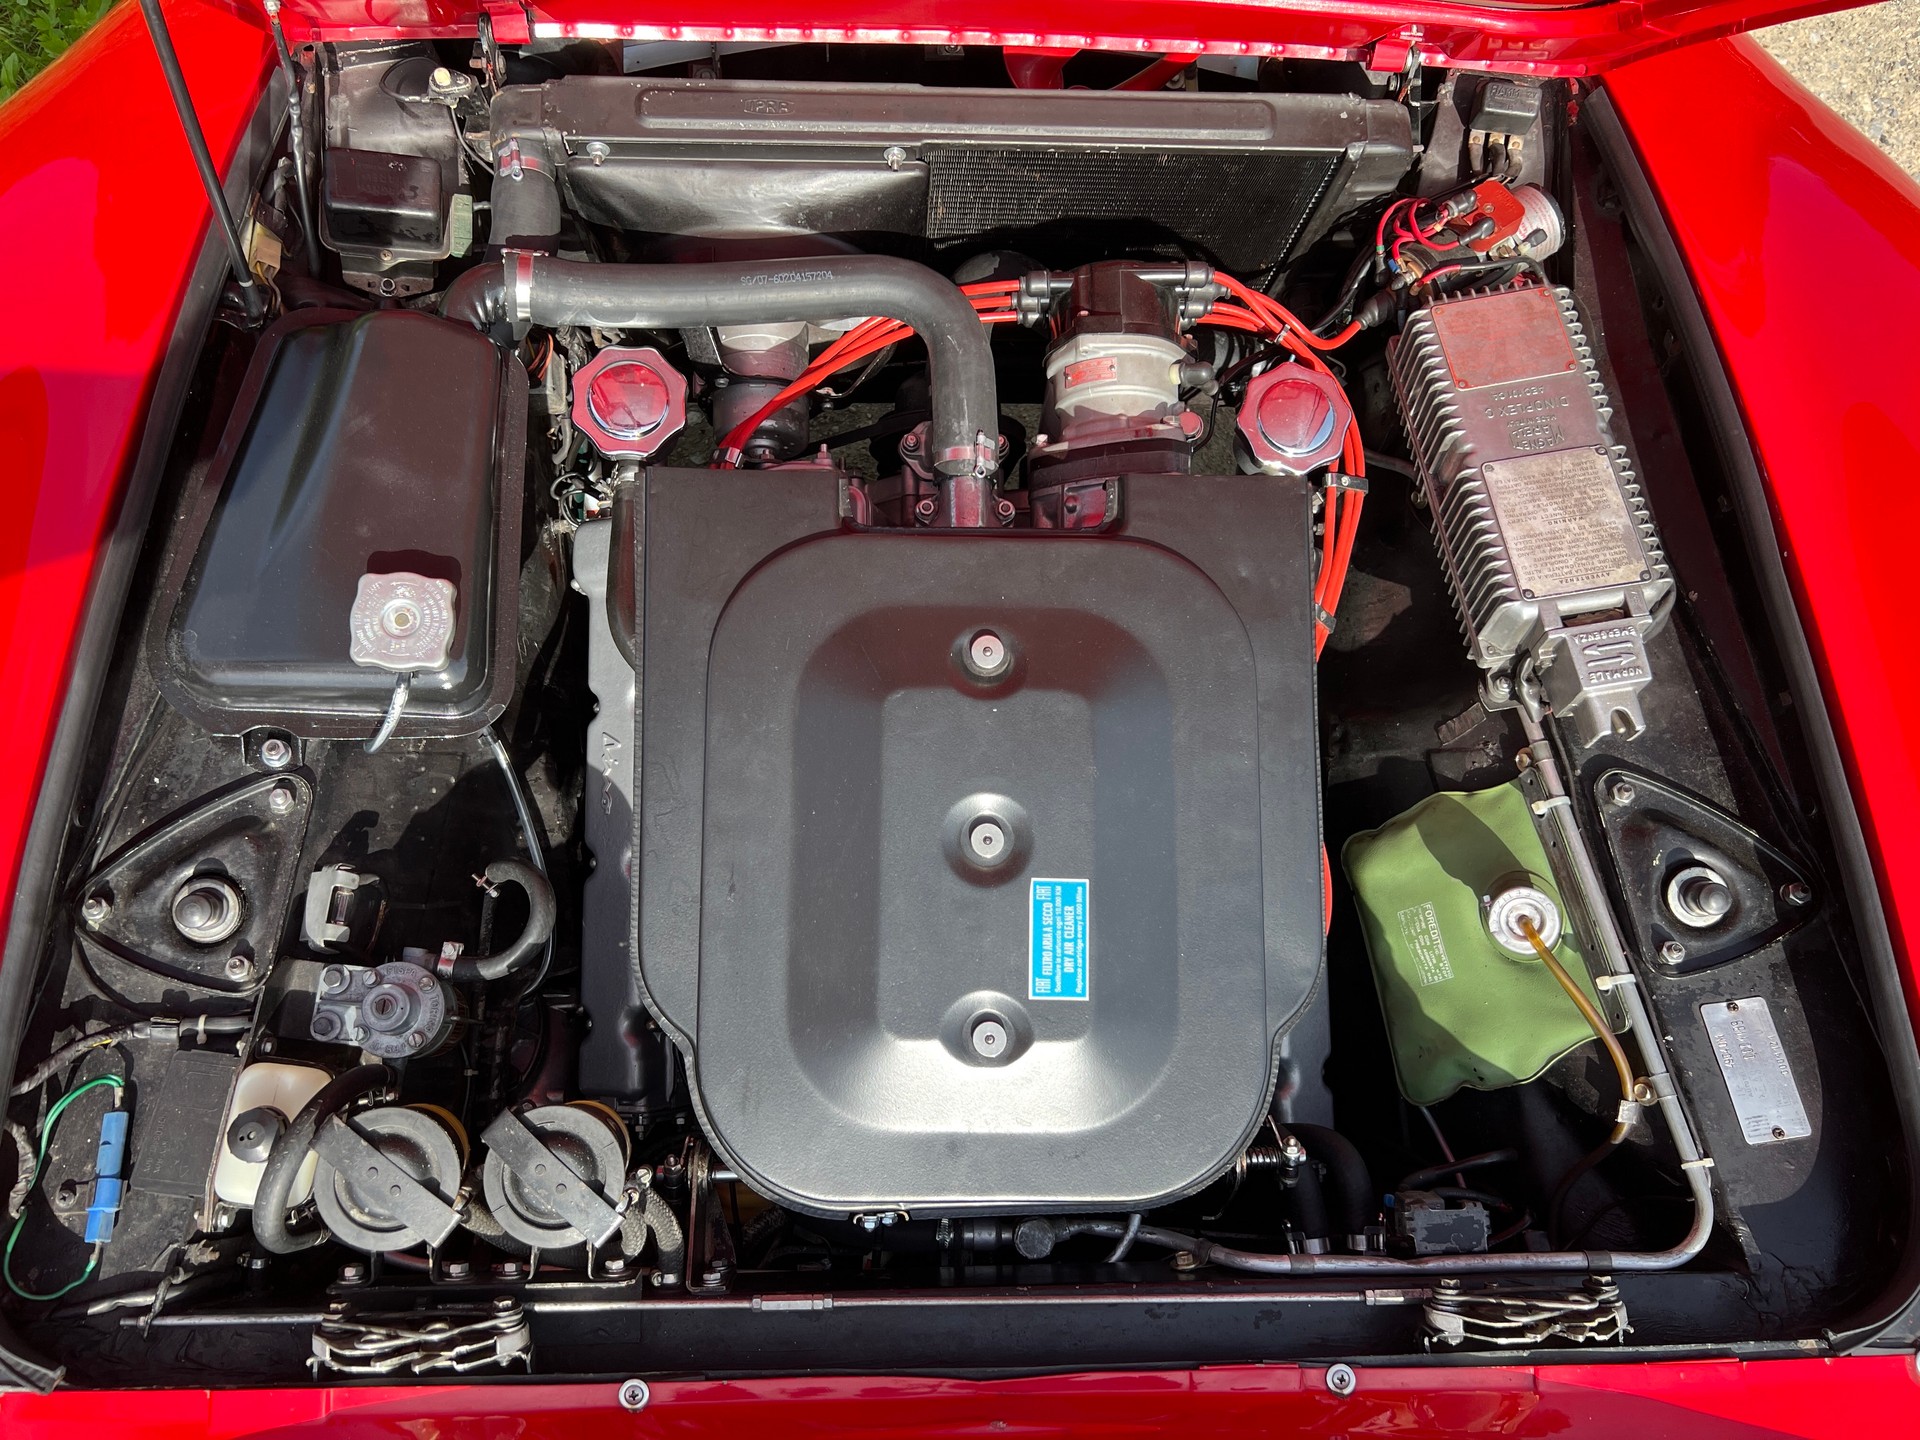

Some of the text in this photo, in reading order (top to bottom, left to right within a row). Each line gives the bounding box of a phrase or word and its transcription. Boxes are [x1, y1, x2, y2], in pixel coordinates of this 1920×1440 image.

[1484, 394, 1568, 419] DINOPLEX C
[1534, 413, 1556, 423] MADE
[1539, 508, 1583, 519] DISCONNECT
[1546, 515, 1584, 525] WARNING
[1546, 560, 1594, 572] FUNZIONANTE
[1558, 571, 1610, 584] AVVERTENZA
[1572, 625, 1637, 644] EMERGENZA
[1588, 665, 1643, 684] NORMALE
[1036, 884, 1051, 900] FIAT
[1055, 885, 1061, 895] KM
[1041, 902, 1053, 925] SECCO
[1055, 915, 1063, 929] ogni
[1421, 903, 1441, 945] FOREDIT
[1041, 933, 1053, 950] ARIA
[1063, 905, 1074, 972] DRY AIR CLEANER
[1075, 939, 1083, 966] cartridge
[1041, 950, 1053, 975] FILTRO
[385, 965, 418, 979] FISPA
[1035, 977, 1050, 993] FIAT
[1075, 968, 1083, 993] Replace
